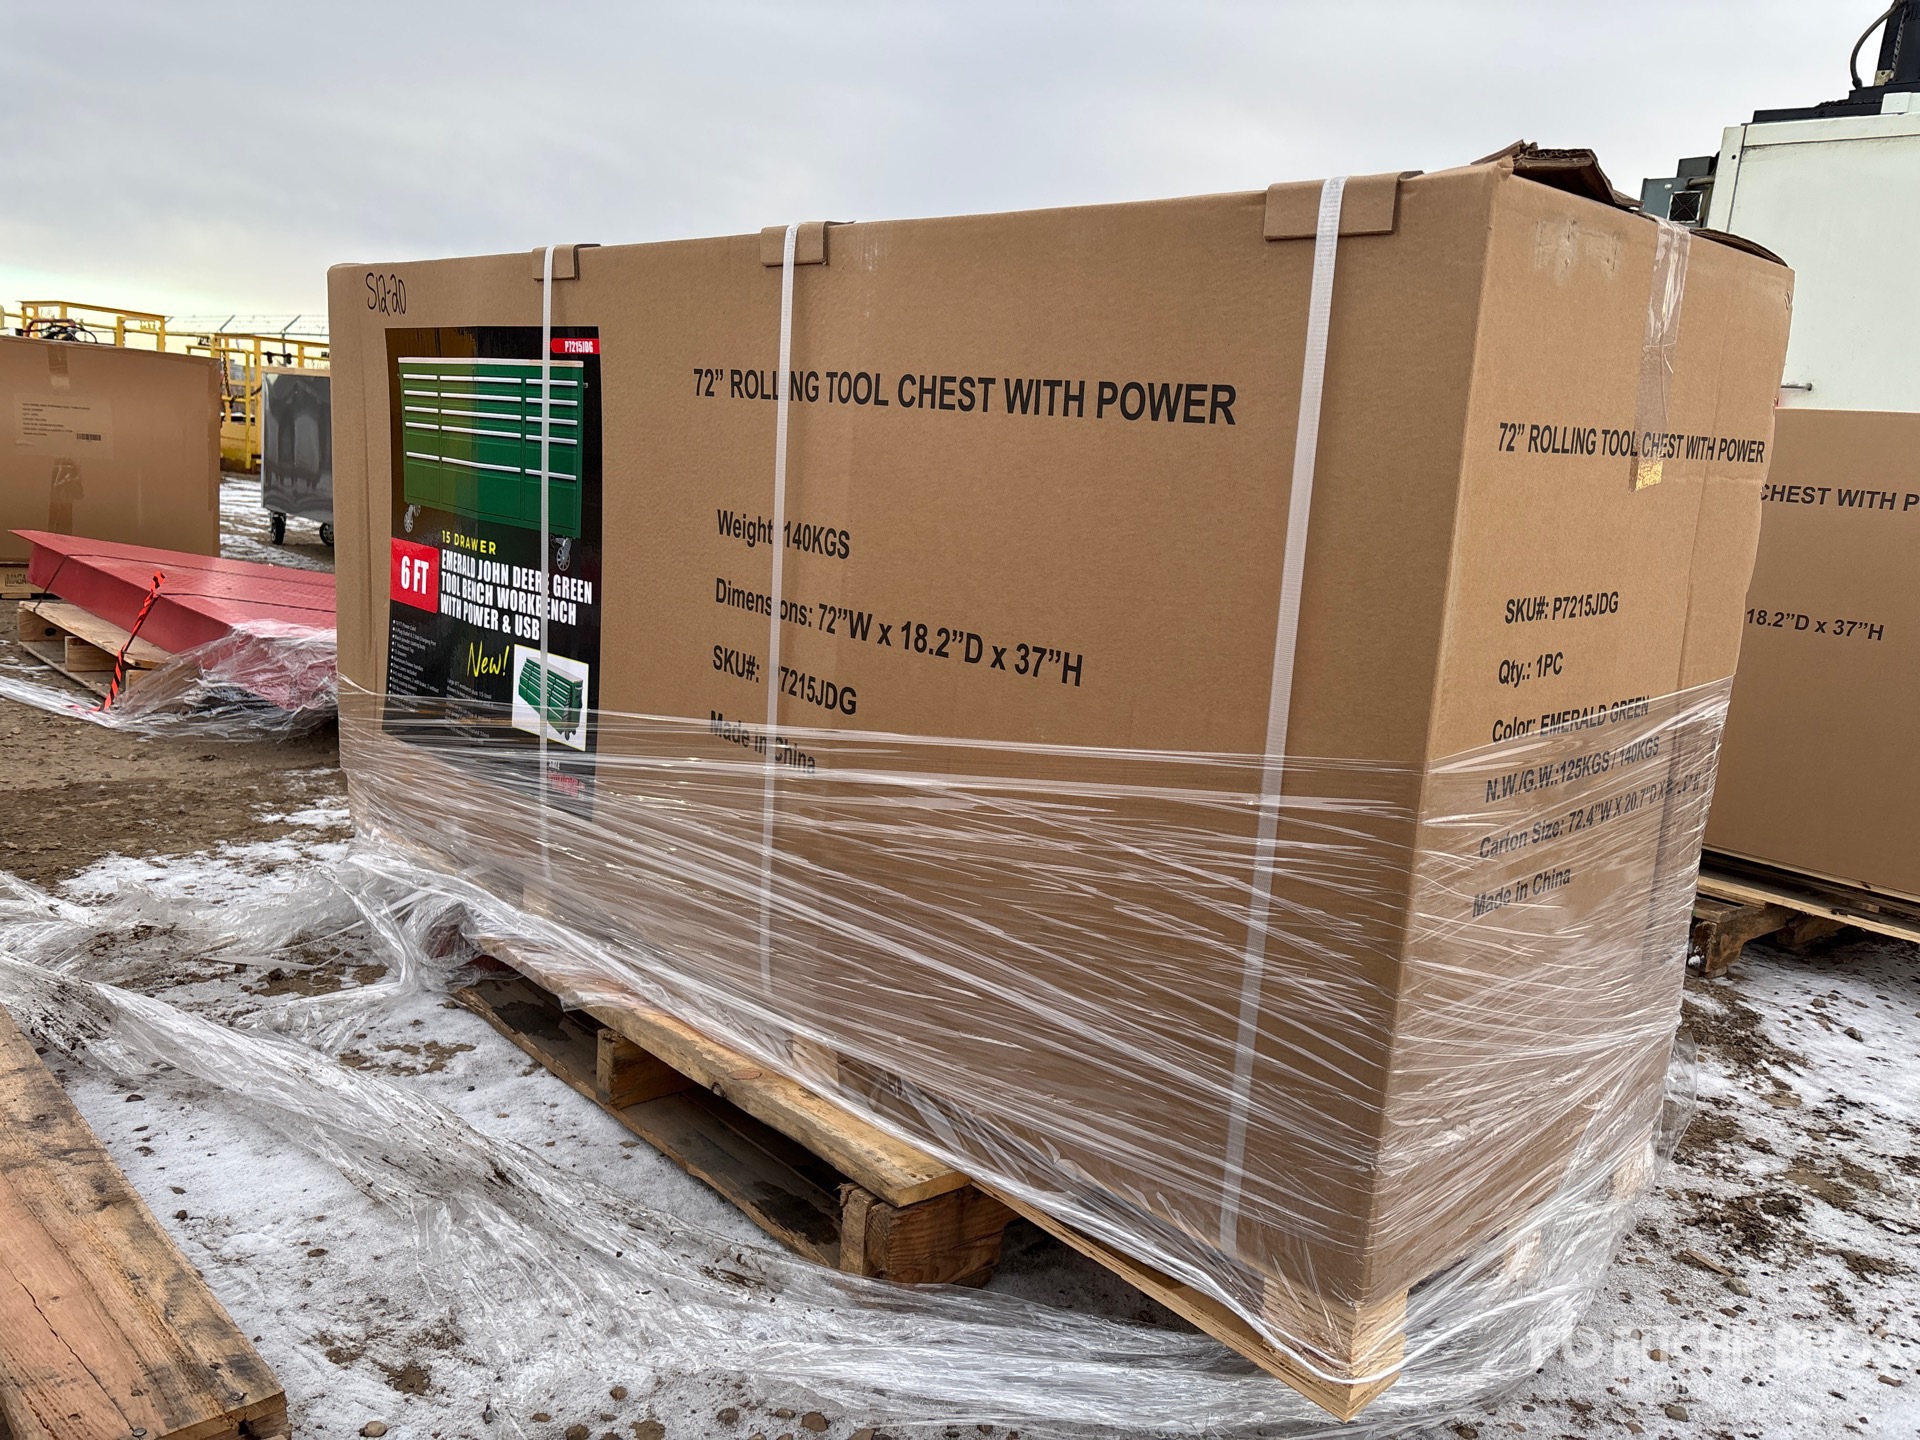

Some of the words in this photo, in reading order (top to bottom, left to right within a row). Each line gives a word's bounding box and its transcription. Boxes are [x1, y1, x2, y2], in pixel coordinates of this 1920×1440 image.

[565, 341, 593, 353] P7215JDG
[730, 369, 819, 402] ROLLNG
[826, 372, 889, 406] TOOL
[898, 374, 996, 412] CHEST
[1004, 378, 1085, 418] WITH
[1096, 381, 1236, 426] POWER
[1528, 424, 1597, 456] ROLLING
[1601, 430, 1638, 457] TOOL
[1642, 432, 1684, 460] CHEST
[1686, 435, 1716, 460] WITH
[1718, 438, 1766, 464] POWER
[1761, 484, 1831, 505] CHEST
[1838, 488, 1896, 510] WITH
[442, 530, 451, 544] 15
[454, 534, 497, 556] DRAWER
[717, 509, 774, 548] Weight
[784, 520, 850, 560] 140KGS
[401, 556, 410, 589] 6
[414, 560, 429, 594] FT
[442, 550, 476, 576] EMERALD
[478, 560, 509, 586] JOHN
[513, 566, 550, 594] DEER
[553, 574, 592, 604] GREEN
[442, 572, 460, 596] TOOL
[462, 580, 494, 606] BENCH
[441, 594, 462, 620] WITH
[464, 602, 499, 631] POWER
[502, 616, 512, 634] &
[514, 614, 540, 641] USB
[716, 578, 812, 628] Dimensons:
[877, 623, 892, 646] x
[990, 646, 1007, 670] x
[1505, 596, 1549, 624] SKU#:
[1552, 591, 1619, 620] P7215JDG
[1814, 620, 1828, 634] x
[467, 640, 510, 678] New!
[1498, 660, 1532, 688] Qty.:
[1536, 652, 1564, 678] 1PC
[712, 645, 760, 683] SKU#:
[778, 666, 856, 715] 7215JDG
[1492, 716, 1536, 742] Color:
[1540, 704, 1608, 736] EMERALD
[1610, 696, 1650, 724] GREEN
[710, 710, 750, 748] Made
[754, 726, 767, 756] in
[775, 736, 816, 774] China
[1620, 736, 1660, 766] 140KGS
[1480, 830, 1528, 858] Carton
[1532, 820, 1564, 844] Size:
[1472, 888, 1511, 918] Made
[1516, 881, 1528, 902] in
[1532, 868, 1570, 895] China
